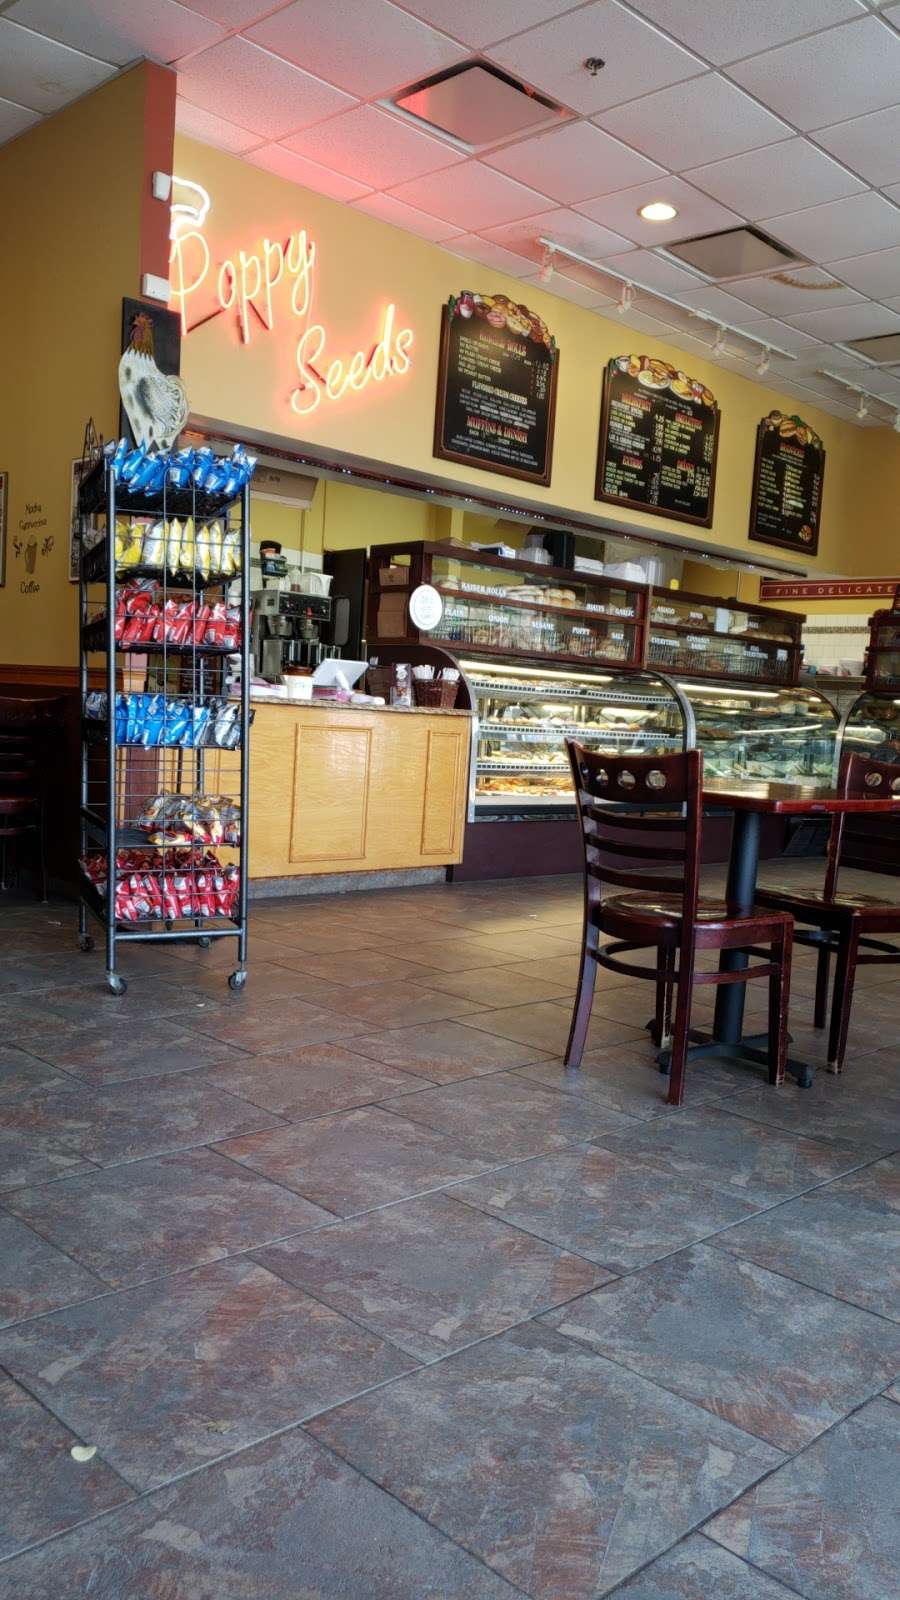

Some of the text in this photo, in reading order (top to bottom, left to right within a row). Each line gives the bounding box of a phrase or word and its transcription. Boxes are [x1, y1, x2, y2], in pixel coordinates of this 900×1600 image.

[170, 230, 315, 344] Poppy
[291, 304, 413, 414] Seeds
[20, 581, 41, 594] Coffee
[486, 587, 506, 598] ROLLS
[445, 609, 464, 618] PLAIN
[615, 608, 634, 617] GARLIC
